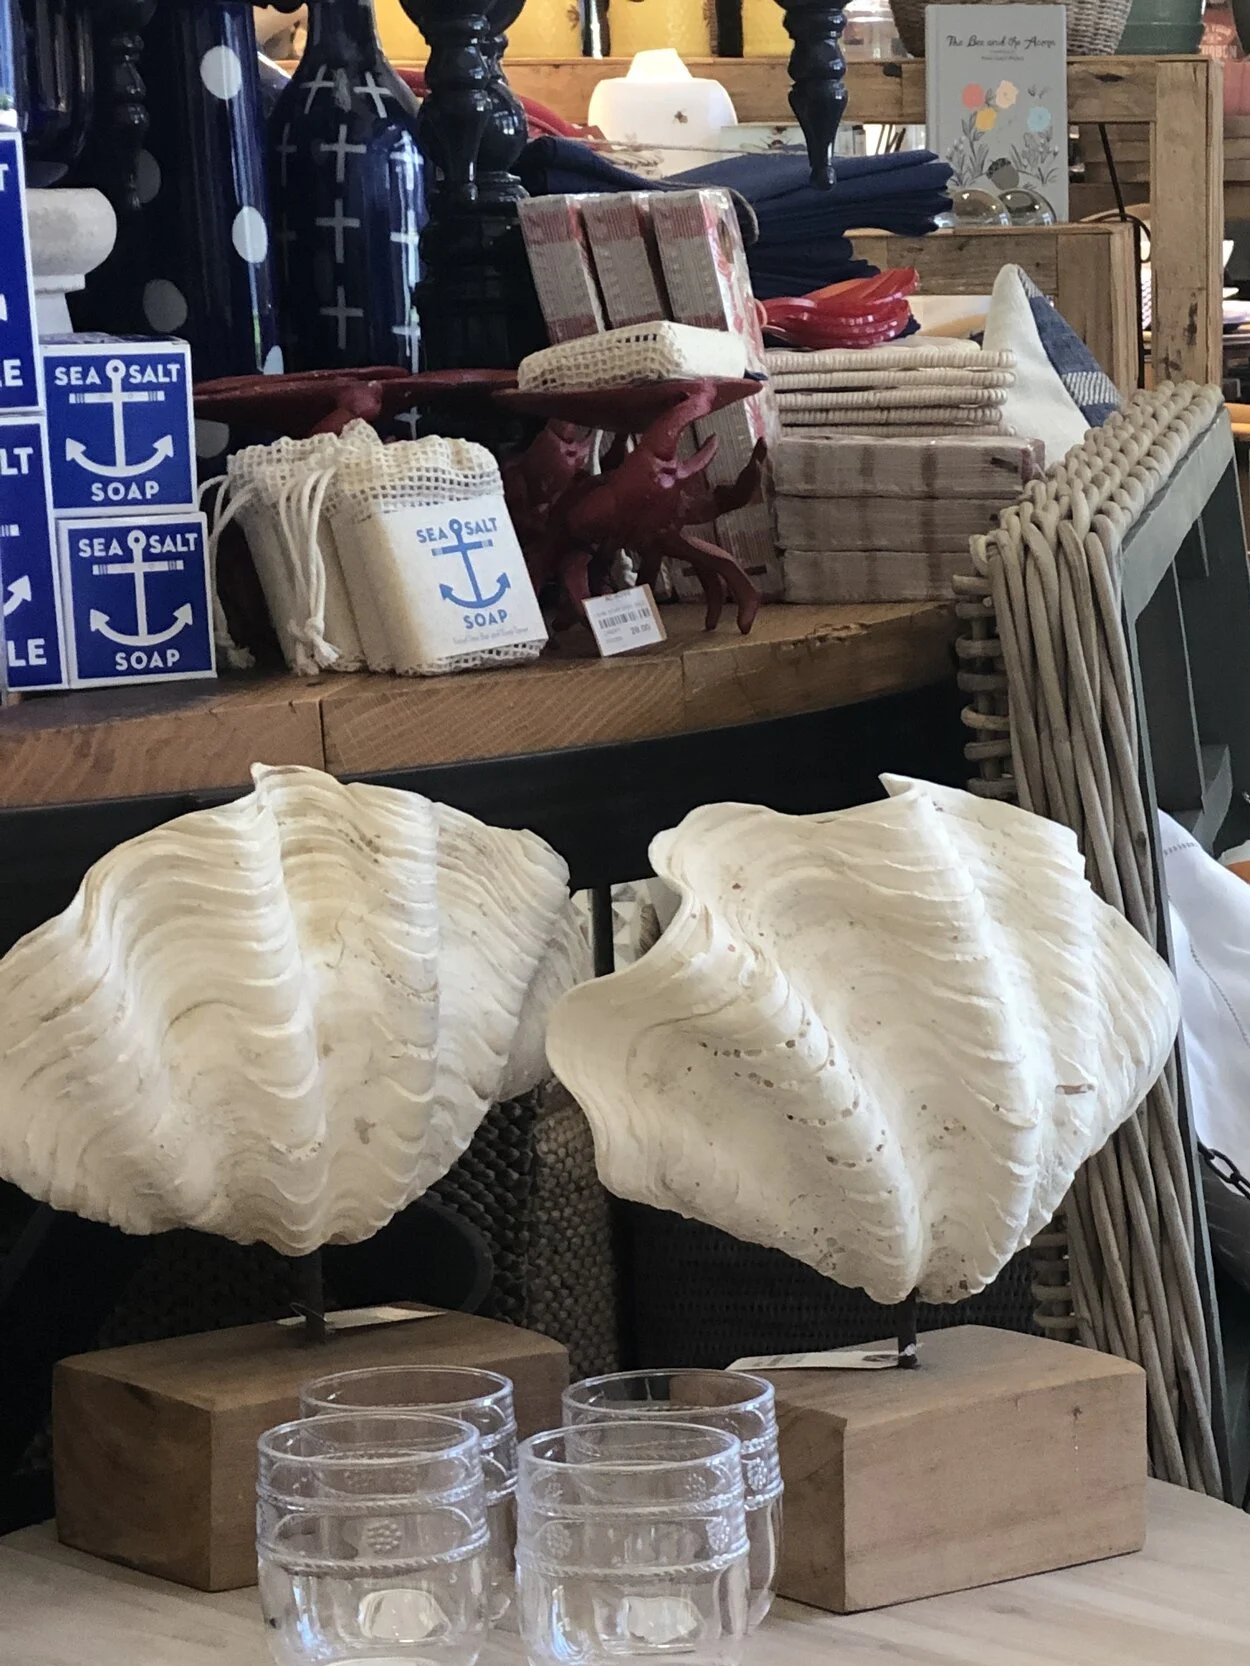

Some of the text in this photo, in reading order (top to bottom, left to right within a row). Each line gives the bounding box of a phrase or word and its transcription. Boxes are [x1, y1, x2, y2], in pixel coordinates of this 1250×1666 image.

[54, 363, 181, 386] SEA SALT
[90, 480, 160, 502] SOAP
[416, 517, 498, 544] SEA SALT
[78, 532, 198, 558] SEA SALT
[463, 608, 508, 630] SOAP
[115, 648, 180, 671] SOAP
